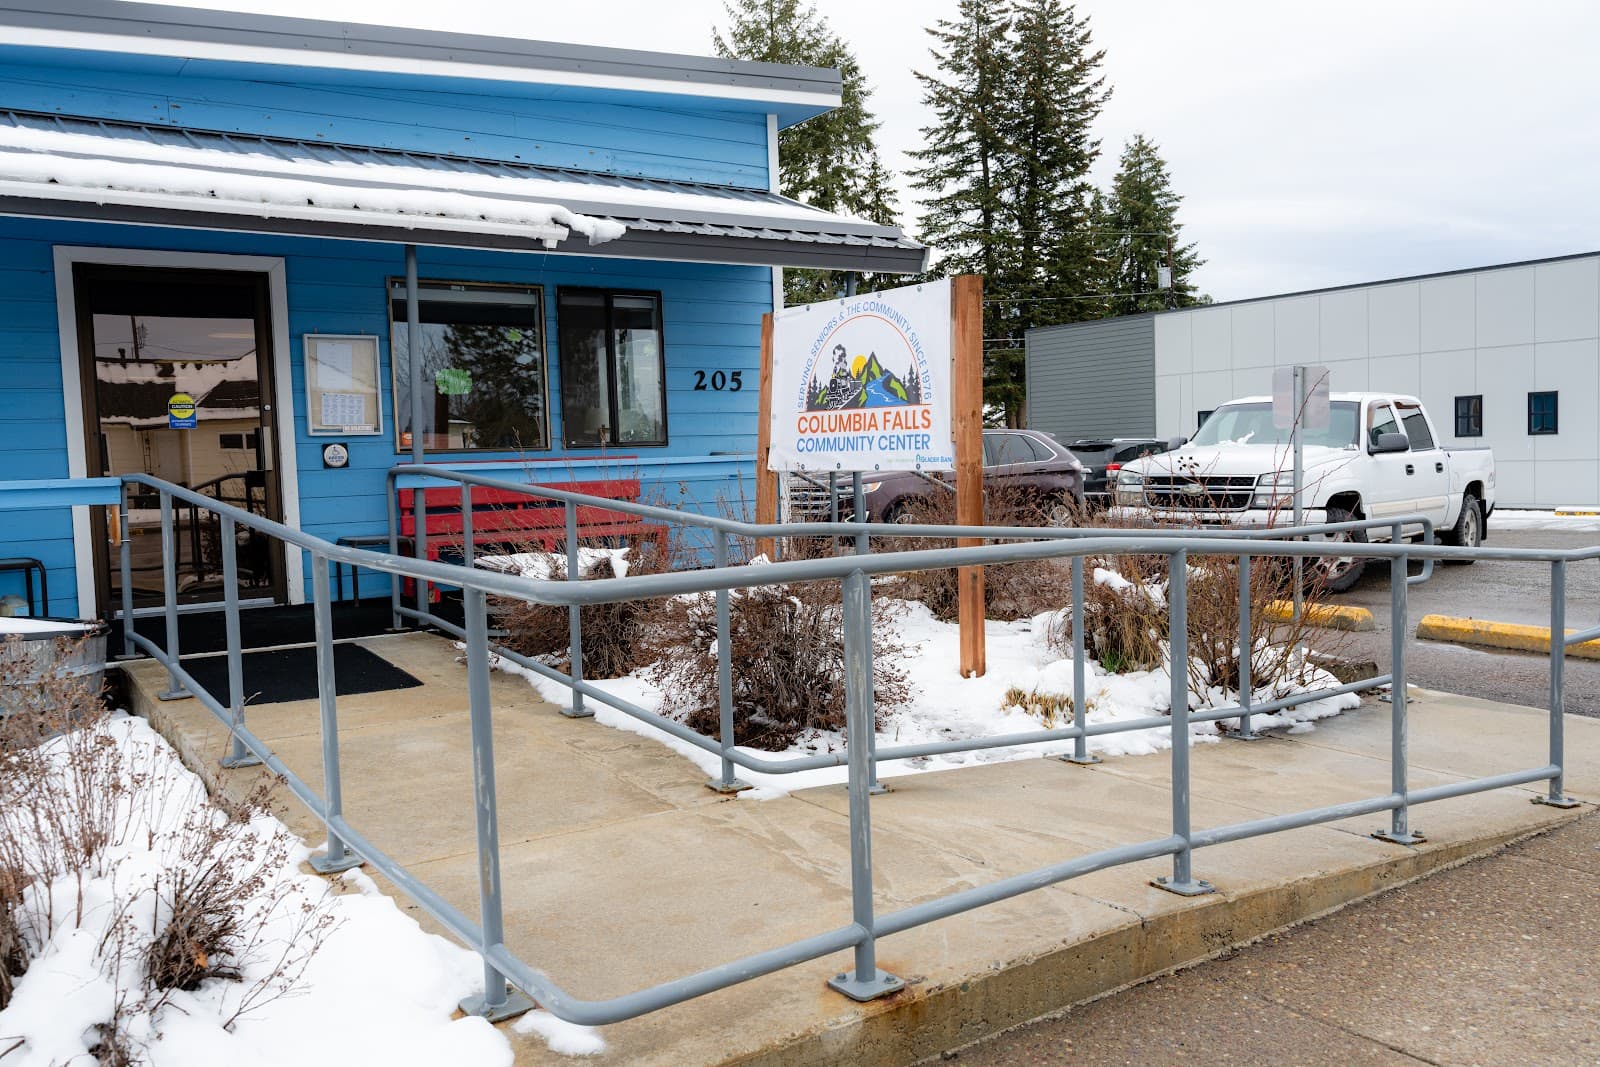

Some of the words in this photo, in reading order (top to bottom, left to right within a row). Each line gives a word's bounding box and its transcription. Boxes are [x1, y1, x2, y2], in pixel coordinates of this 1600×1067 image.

[798, 358, 813, 408] SERVING
[811, 317, 838, 358] SENIORS
[838, 311, 846, 321] &
[847, 302, 861, 316] THE
[863, 301, 912, 333] COMMUNITY
[909, 332, 927, 369] SINCE
[920, 369, 932, 400] 1976
[694, 370, 743, 392] 205
[797, 412, 879, 434] COLUMBIA
[883, 409, 932, 431] FALLS
[796, 435, 875, 453] COMMUNITY
[878, 433, 931, 451] CENTER
